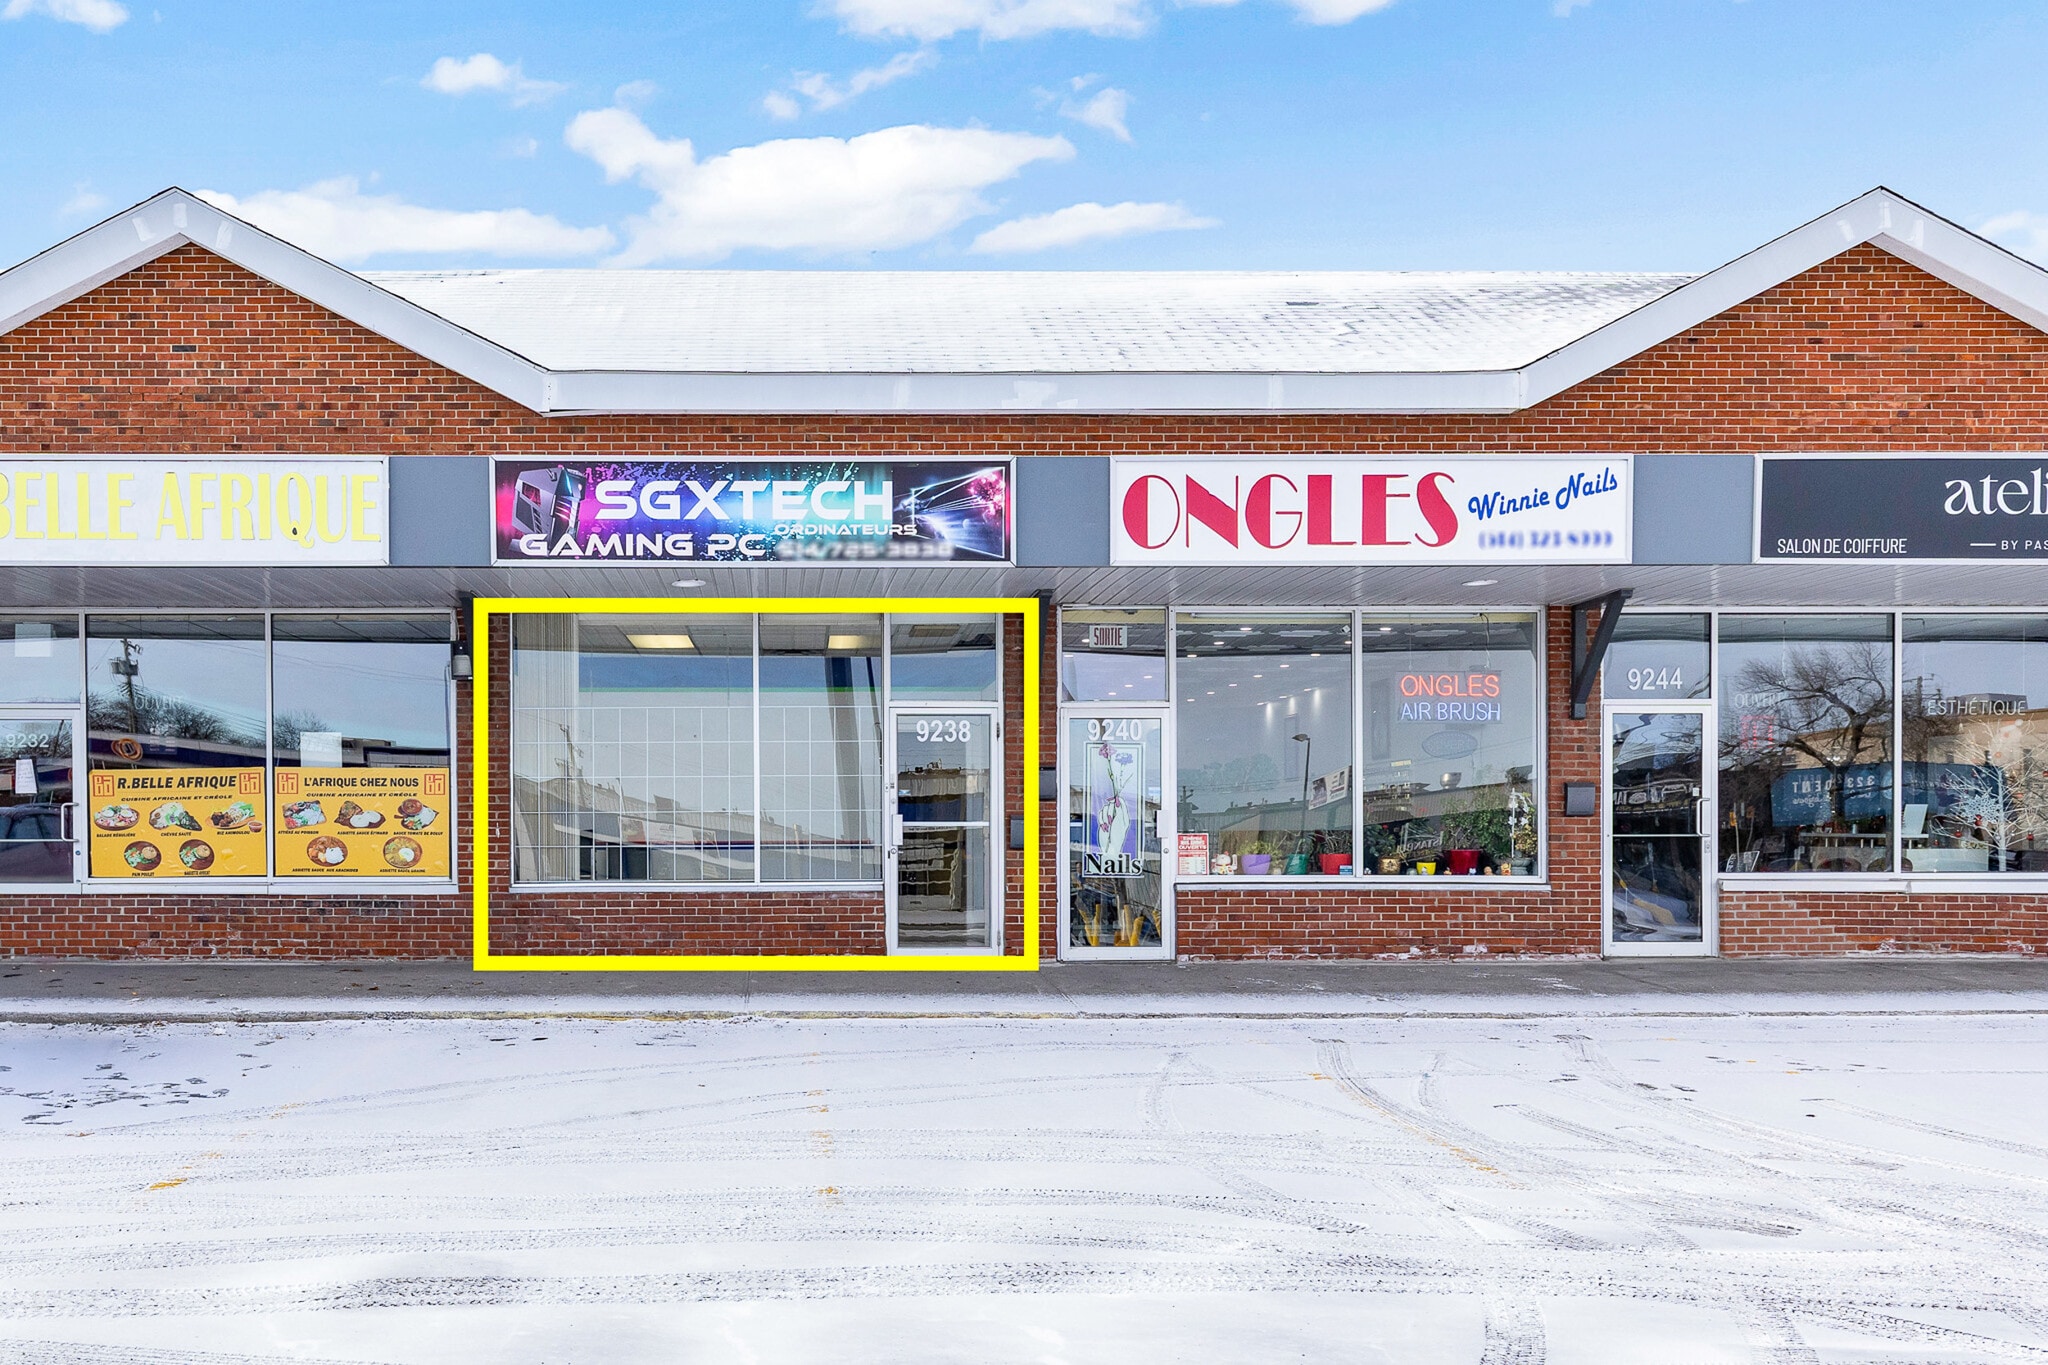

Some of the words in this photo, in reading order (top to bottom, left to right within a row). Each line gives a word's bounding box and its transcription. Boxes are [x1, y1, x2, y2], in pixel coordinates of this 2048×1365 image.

[595, 480, 893, 520] SGXTECH
[1467, 487, 1551, 521] Winnie
[1555, 466, 1618, 510] Nails
[155, 472, 381, 548] AFRIQUE
[1122, 472, 1459, 550] ONGLES
[773, 523, 918, 536] ORDINATEURS
[519, 533, 694, 557] GAMING
[707, 533, 766, 557] PC
[1777, 537, 1822, 554] SALON
[1823, 537, 1841, 554] DE
[1845, 537, 1908, 554] COIFFURE
[2001, 540, 2019, 551] BY
[1093, 626, 1123, 647] SORTIE
[1400, 674, 1500, 698] ONGLES
[1627, 667, 1683, 691] 9244
[1400, 702, 1432, 721] AIR
[1437, 702, 1501, 721] BRUSH
[1927, 697, 2027, 716] ESTHÉTIQUE
[6, 733, 50, 748] 9232
[916, 719, 971, 743] 9238
[1087, 719, 1142, 742] 9240
[117, 777, 174, 789] R.BELLE
[177, 775, 237, 789] AFRIQUE
[303, 777, 358, 788] L'AFRIQUE
[359, 777, 388, 787] CHEZ
[389, 777, 419, 787] NOUS
[1085, 853, 1142, 876] Nails
